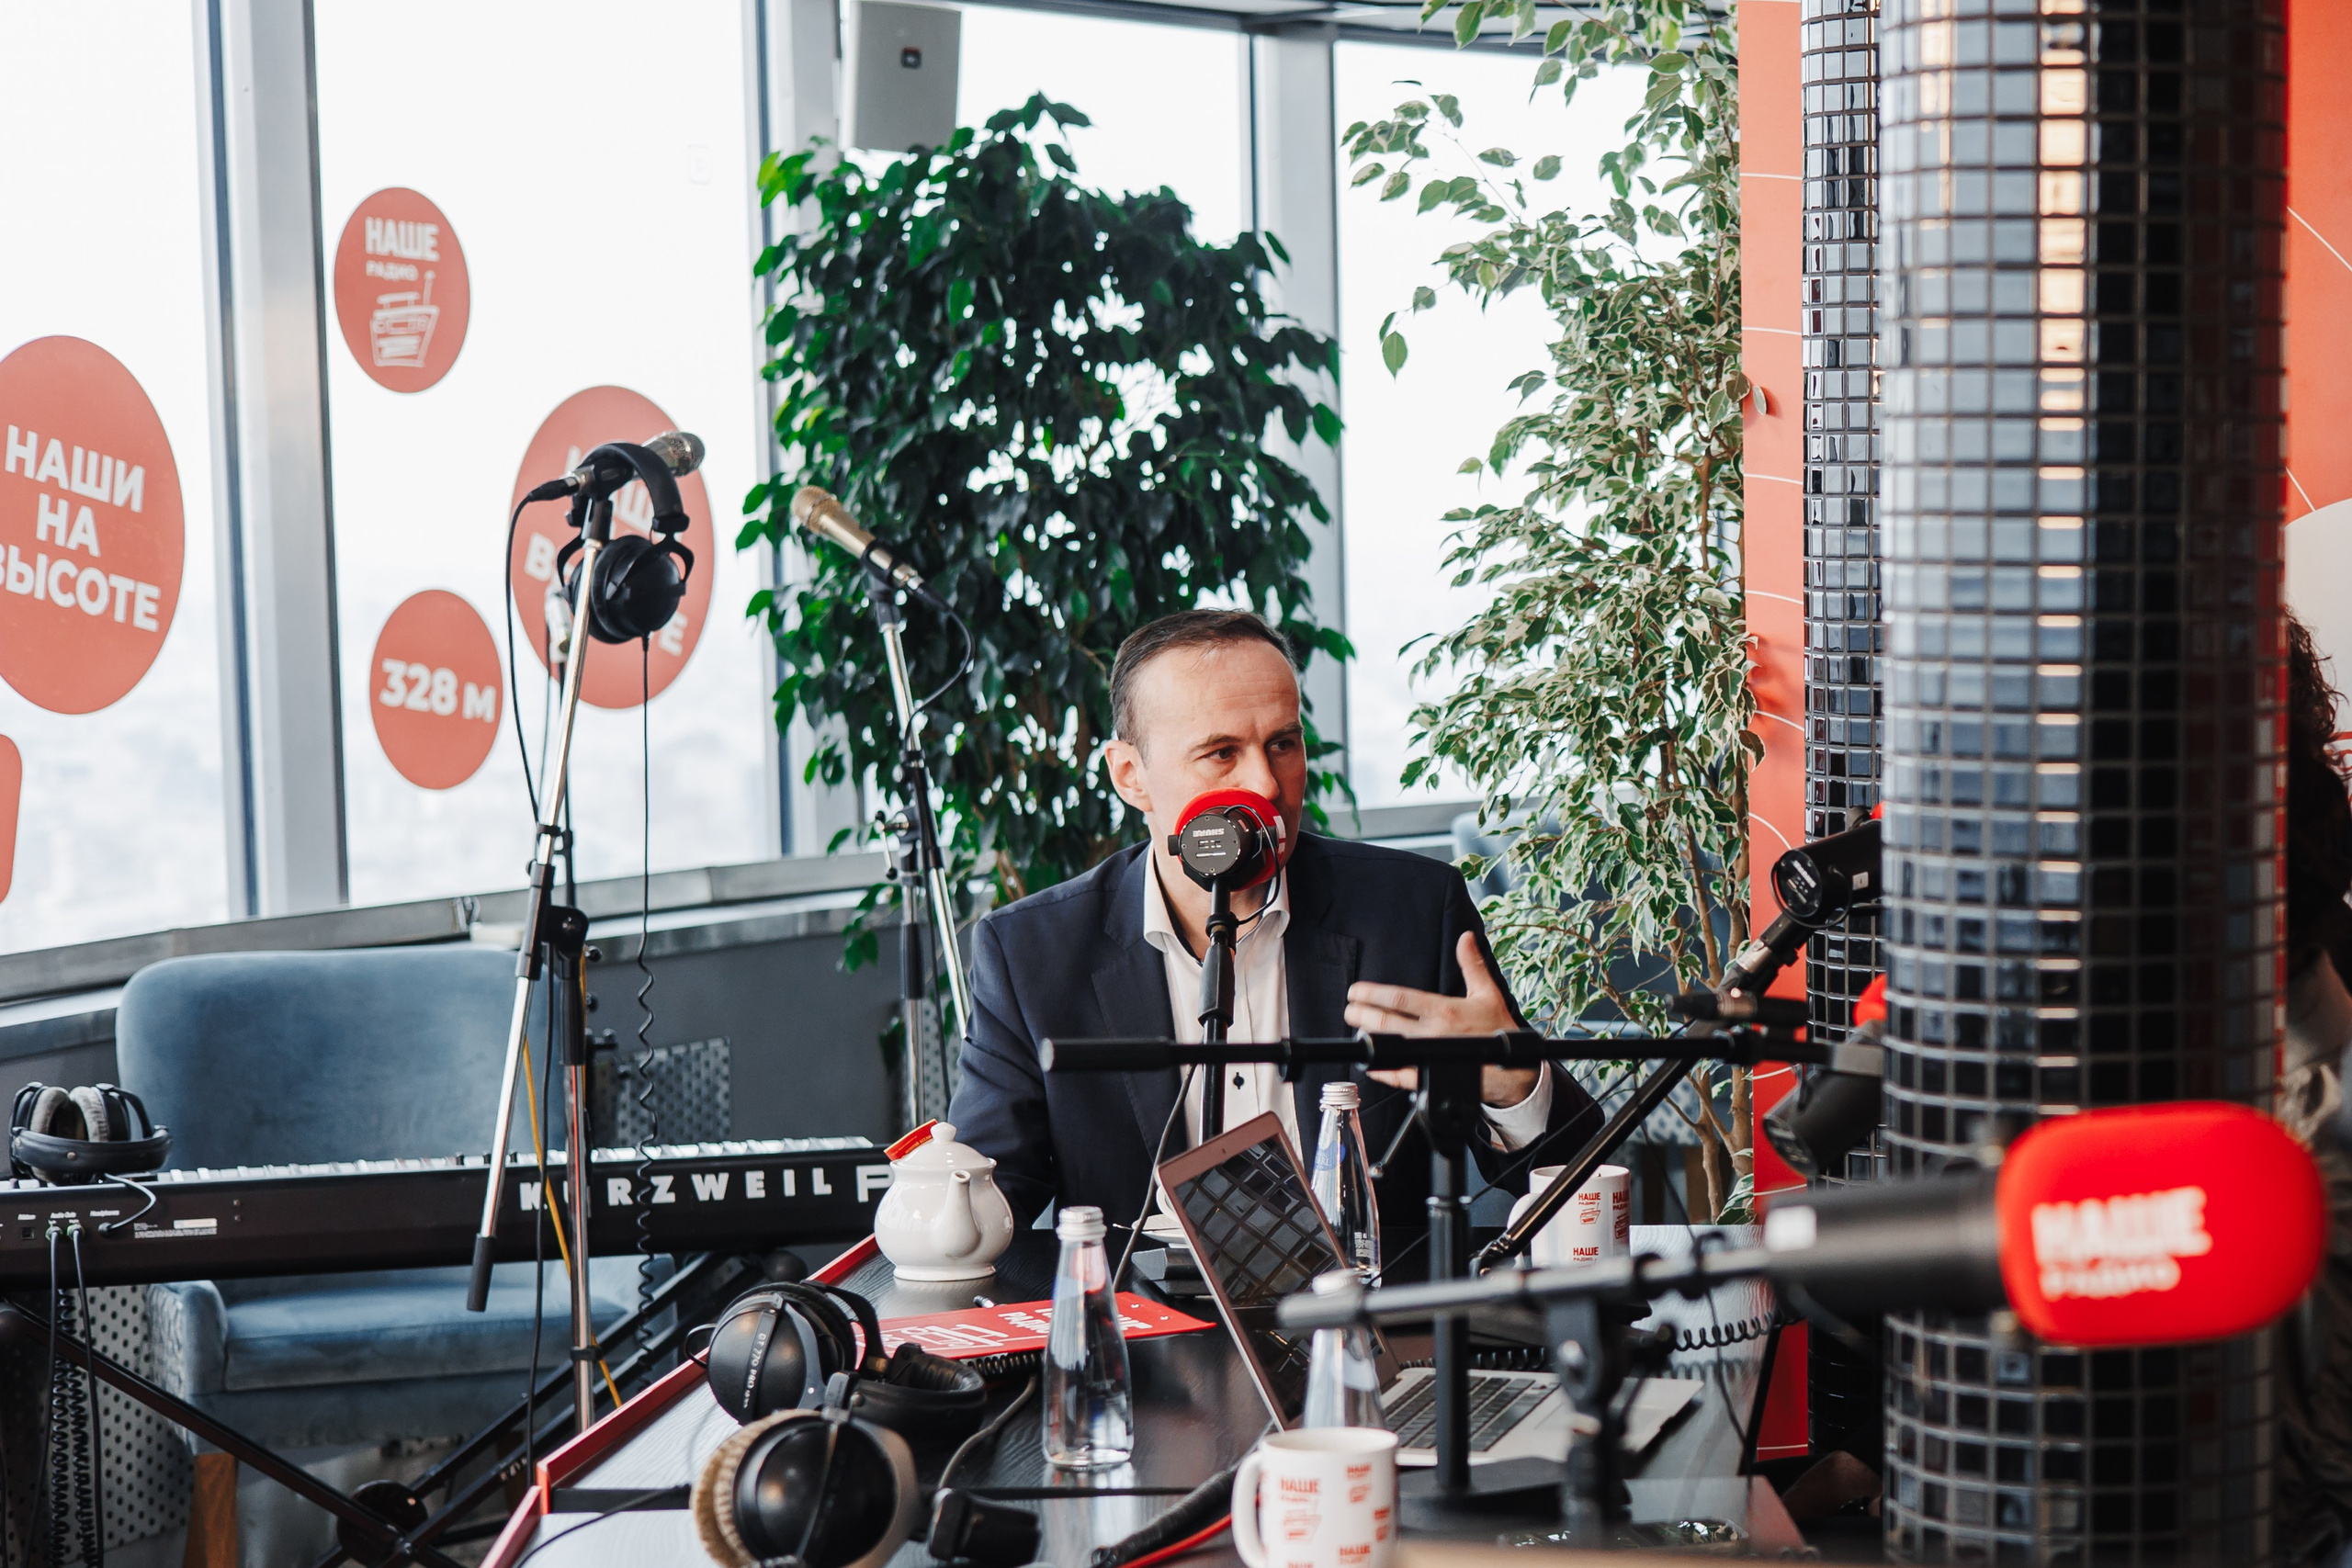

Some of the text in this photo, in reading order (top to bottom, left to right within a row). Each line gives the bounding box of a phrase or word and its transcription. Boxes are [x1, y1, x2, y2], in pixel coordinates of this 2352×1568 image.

[365, 216, 440, 262] НАШЕ
[5, 423, 145, 513] НАШИ
[36, 492, 101, 558] НА
[0, 542, 161, 632] ЫСОТЕ
[379, 658, 458, 716] 328
[1577, 1192, 1600, 1201] НАШЕ
[1573, 1247, 1599, 1256] НАШЕ
[757, 1333, 767, 1347] DT
[752, 1347, 763, 1367] 770
[747, 1369, 758, 1389] PRO
